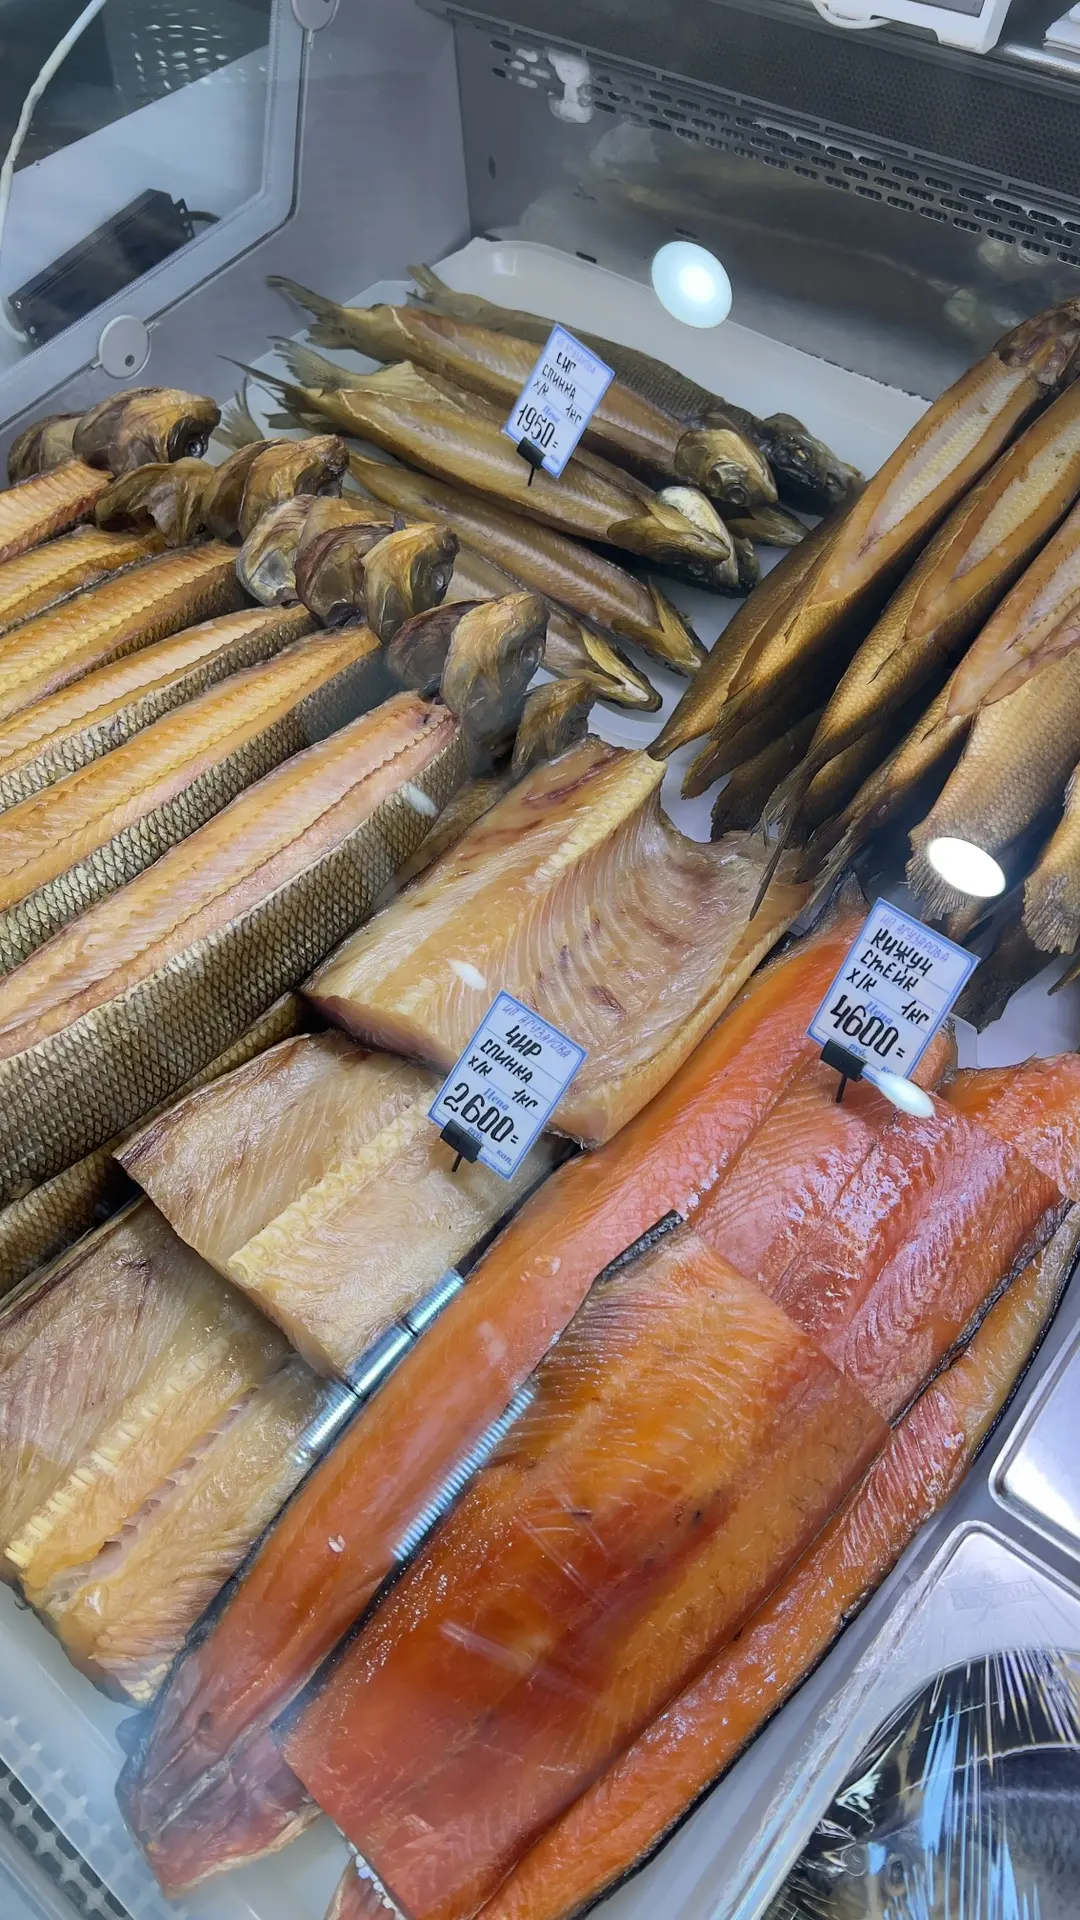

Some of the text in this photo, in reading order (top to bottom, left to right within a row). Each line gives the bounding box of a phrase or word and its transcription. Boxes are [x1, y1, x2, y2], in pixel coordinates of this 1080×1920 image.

[870, 927, 933, 976] КИЖУЧ
[480, 1038, 533, 1083] СПИНКА
[505, 1025, 542, 1057] ЧИР
